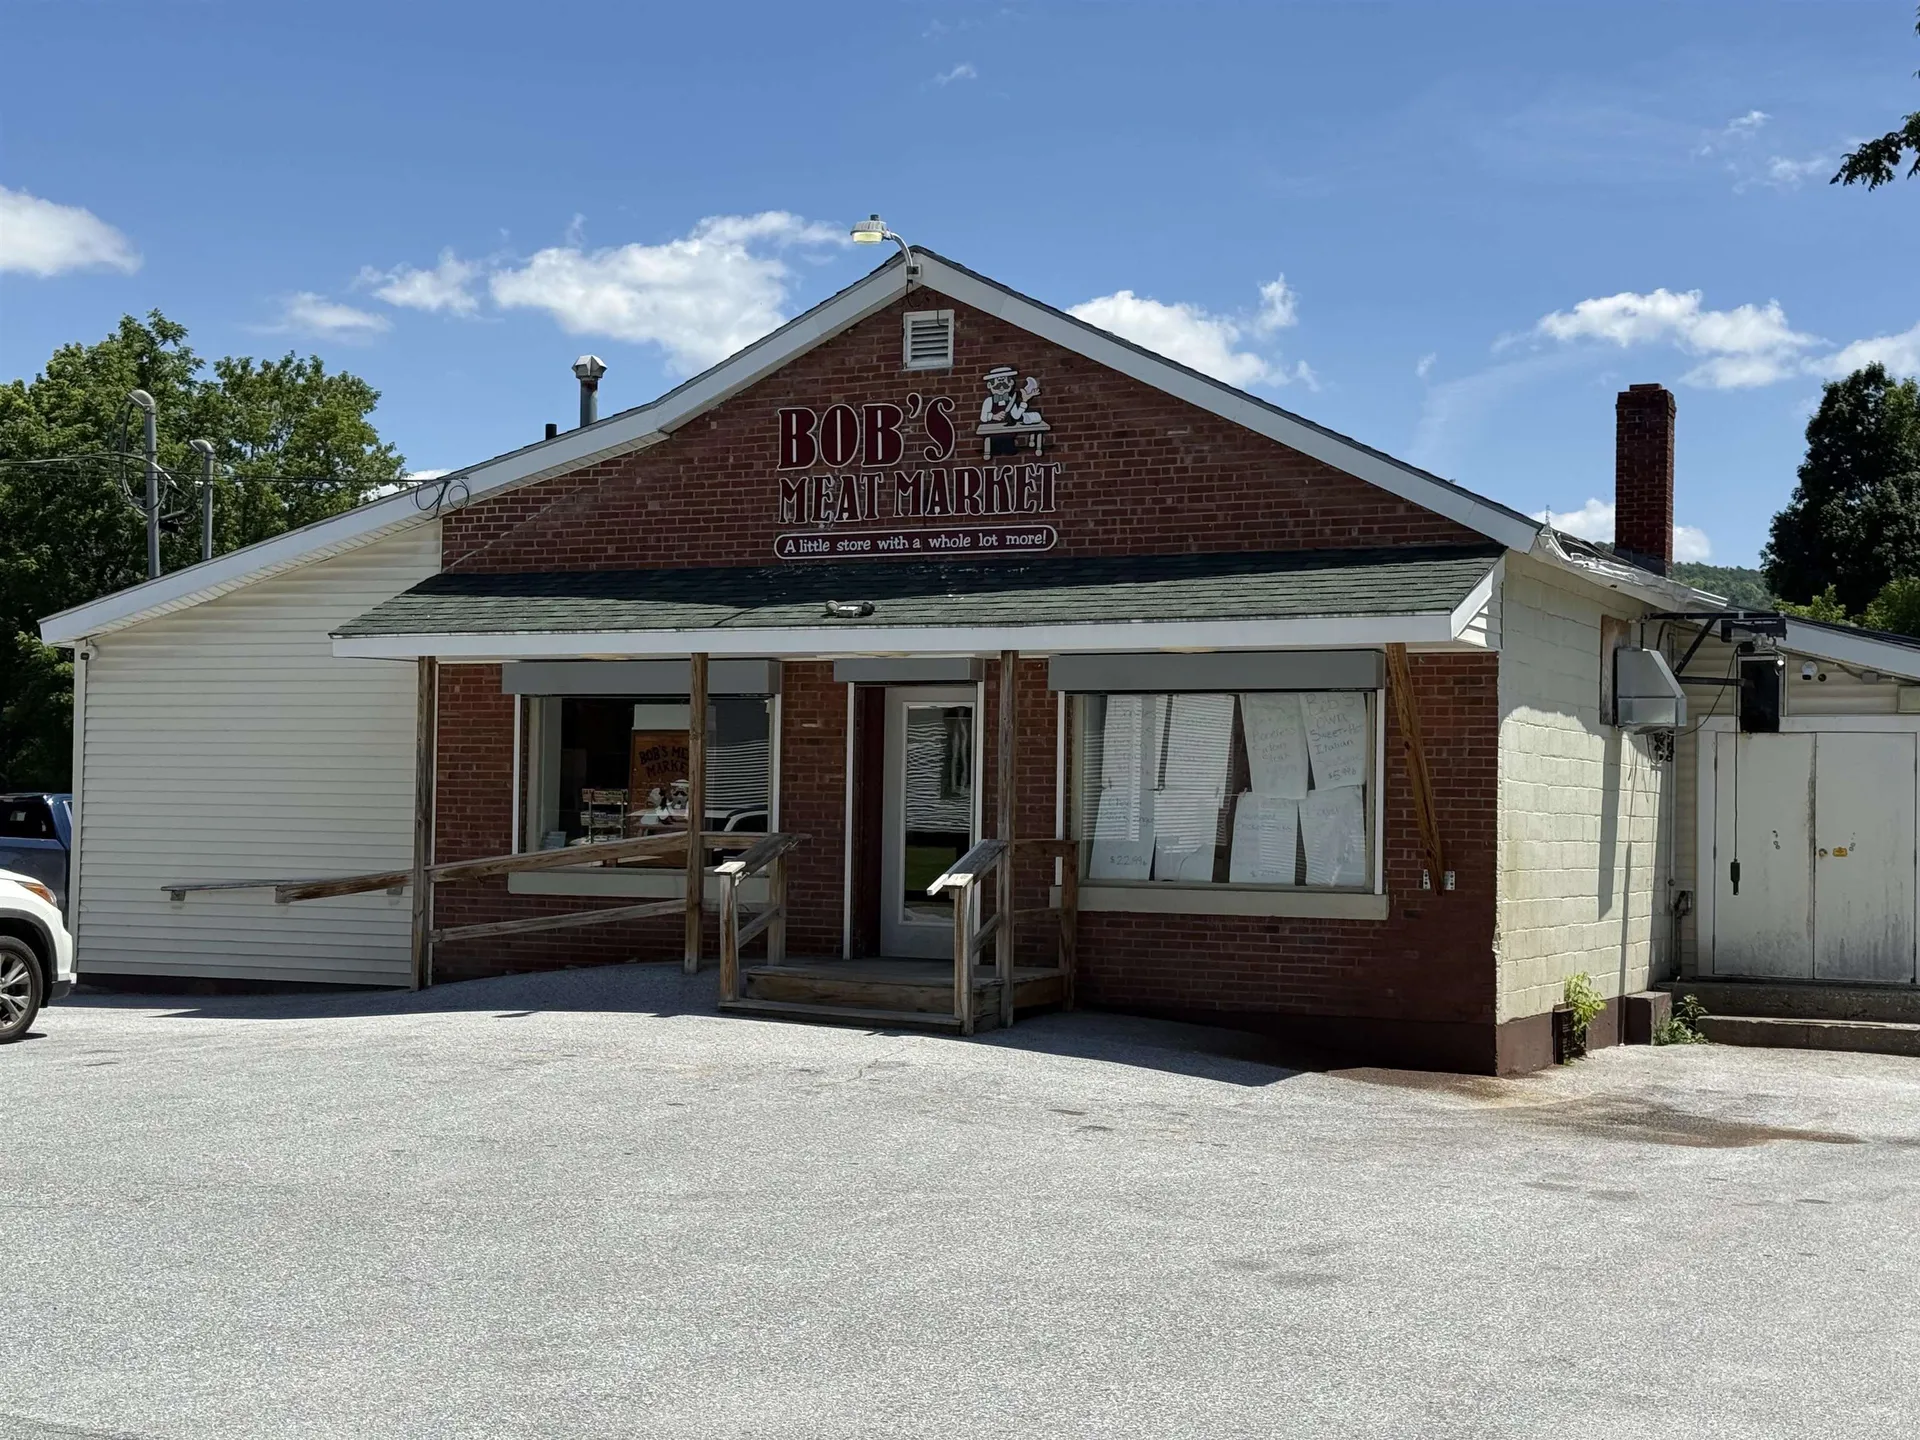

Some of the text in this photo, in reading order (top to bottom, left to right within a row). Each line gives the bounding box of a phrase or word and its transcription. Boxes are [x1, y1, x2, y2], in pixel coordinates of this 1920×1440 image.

[777, 392, 956, 471] BOB'S
[777, 462, 1061, 525] MEAT MARKET
[783, 529, 1047, 554] A little store with a whole lot more!
[646, 759, 690, 776] MARKE
